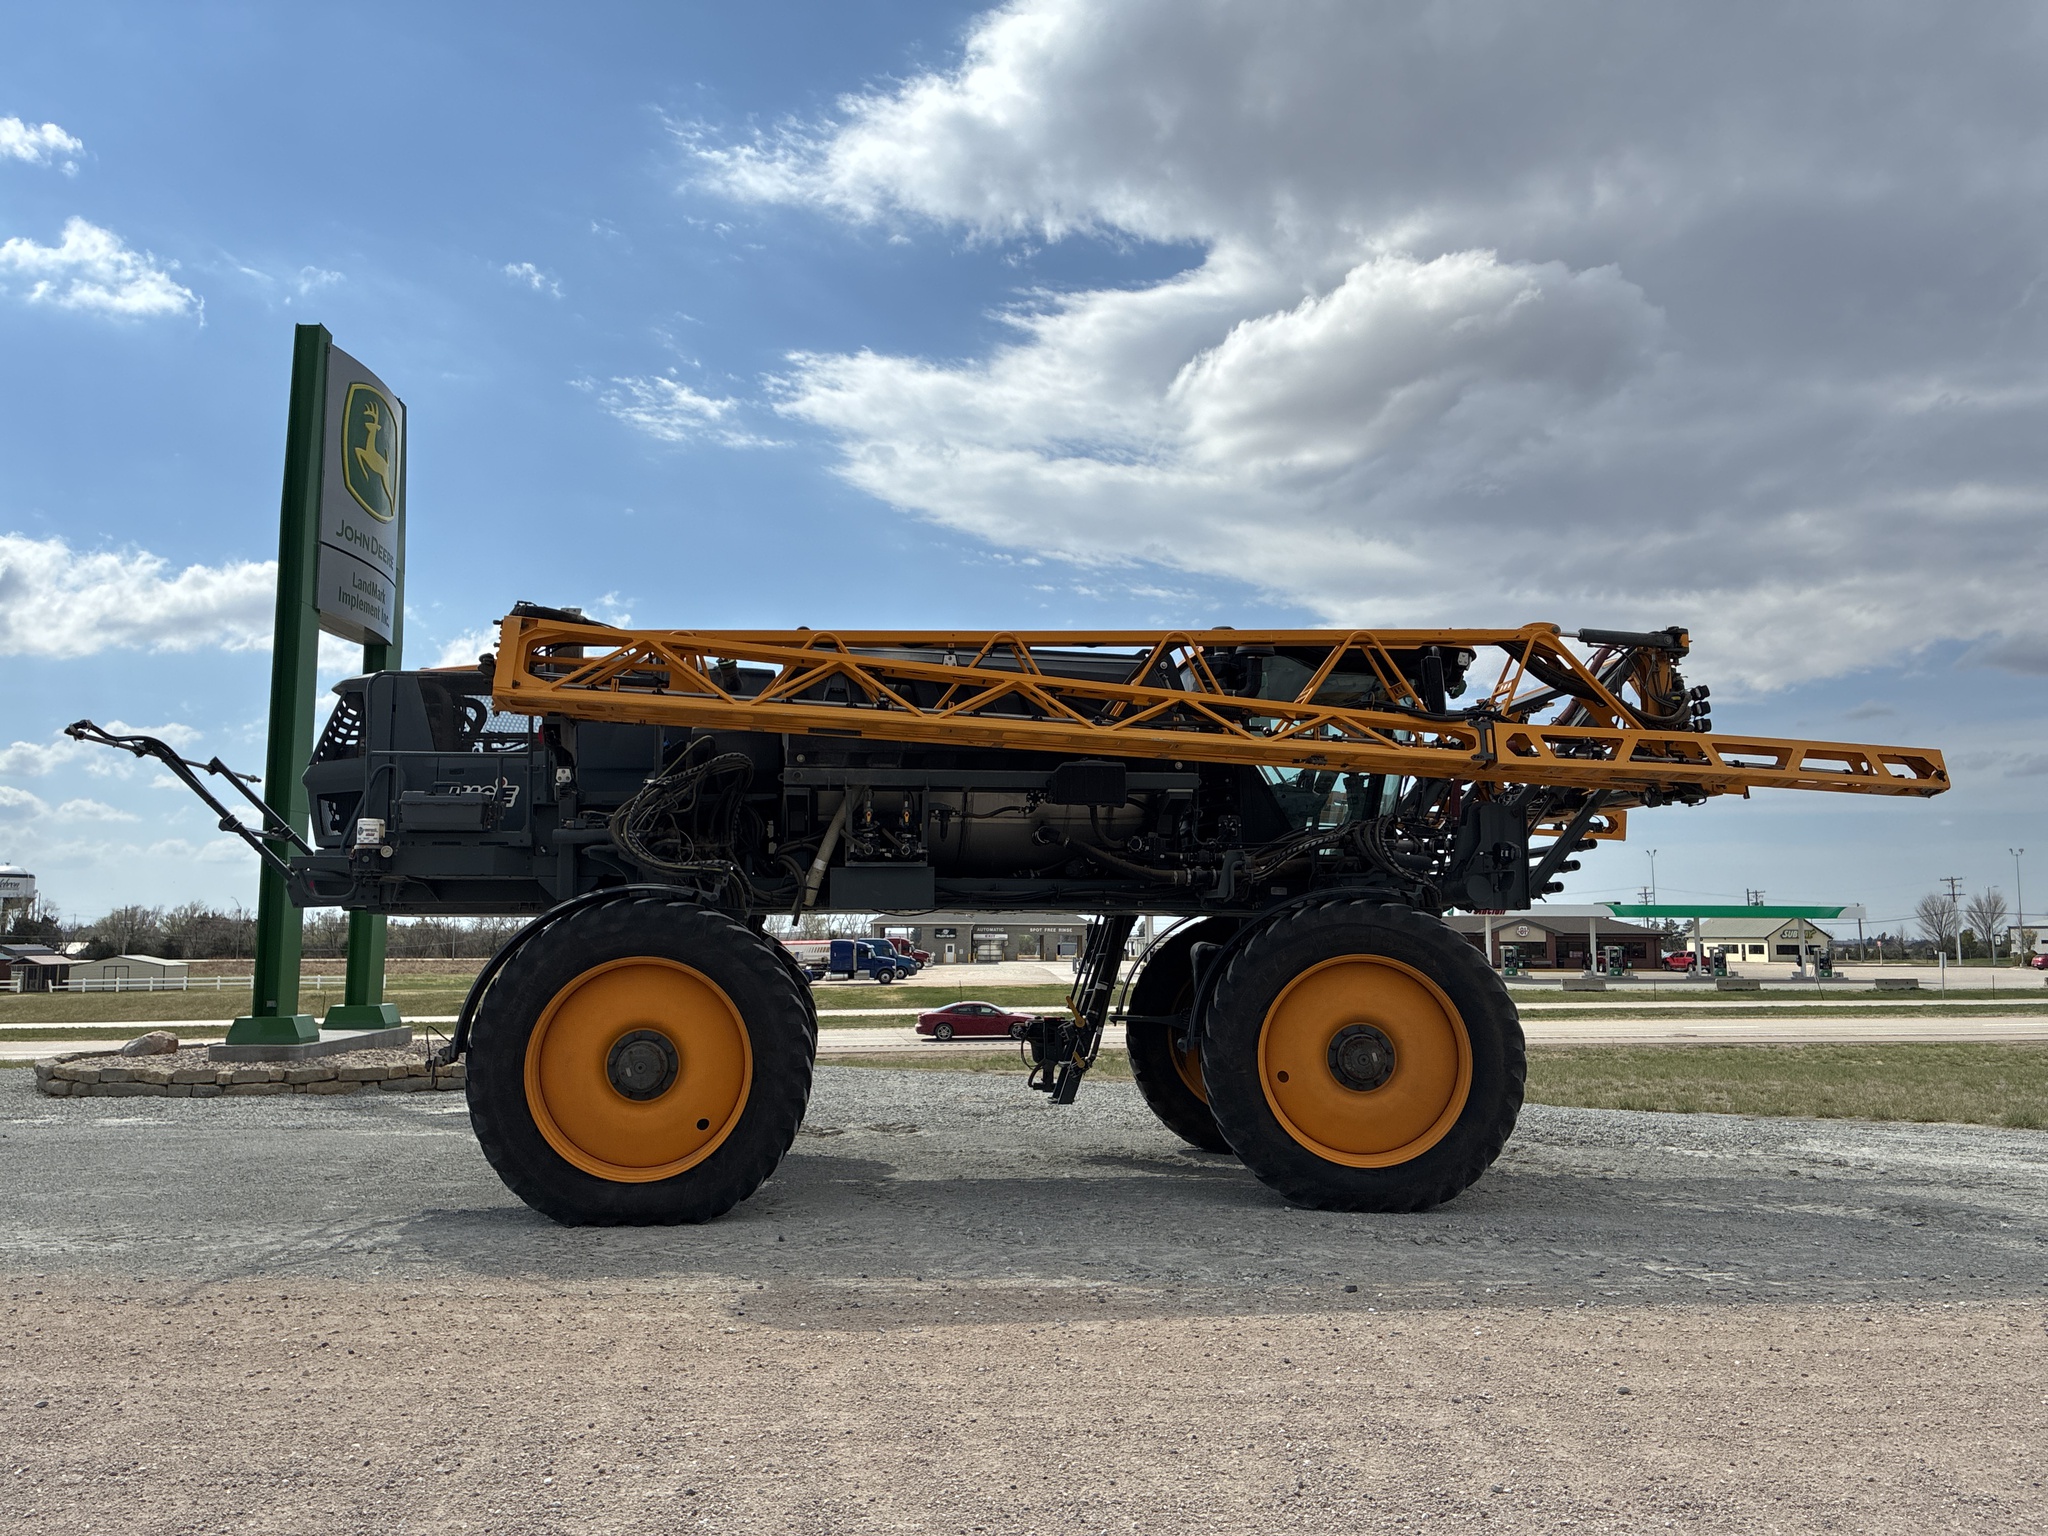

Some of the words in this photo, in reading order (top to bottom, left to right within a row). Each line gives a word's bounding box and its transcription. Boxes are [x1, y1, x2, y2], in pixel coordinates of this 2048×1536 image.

[336, 520, 370, 552] JOHN
[371, 535, 395, 571] DEERE
[338, 586, 381, 621] Implement
[352, 572, 386, 605] LandMark
